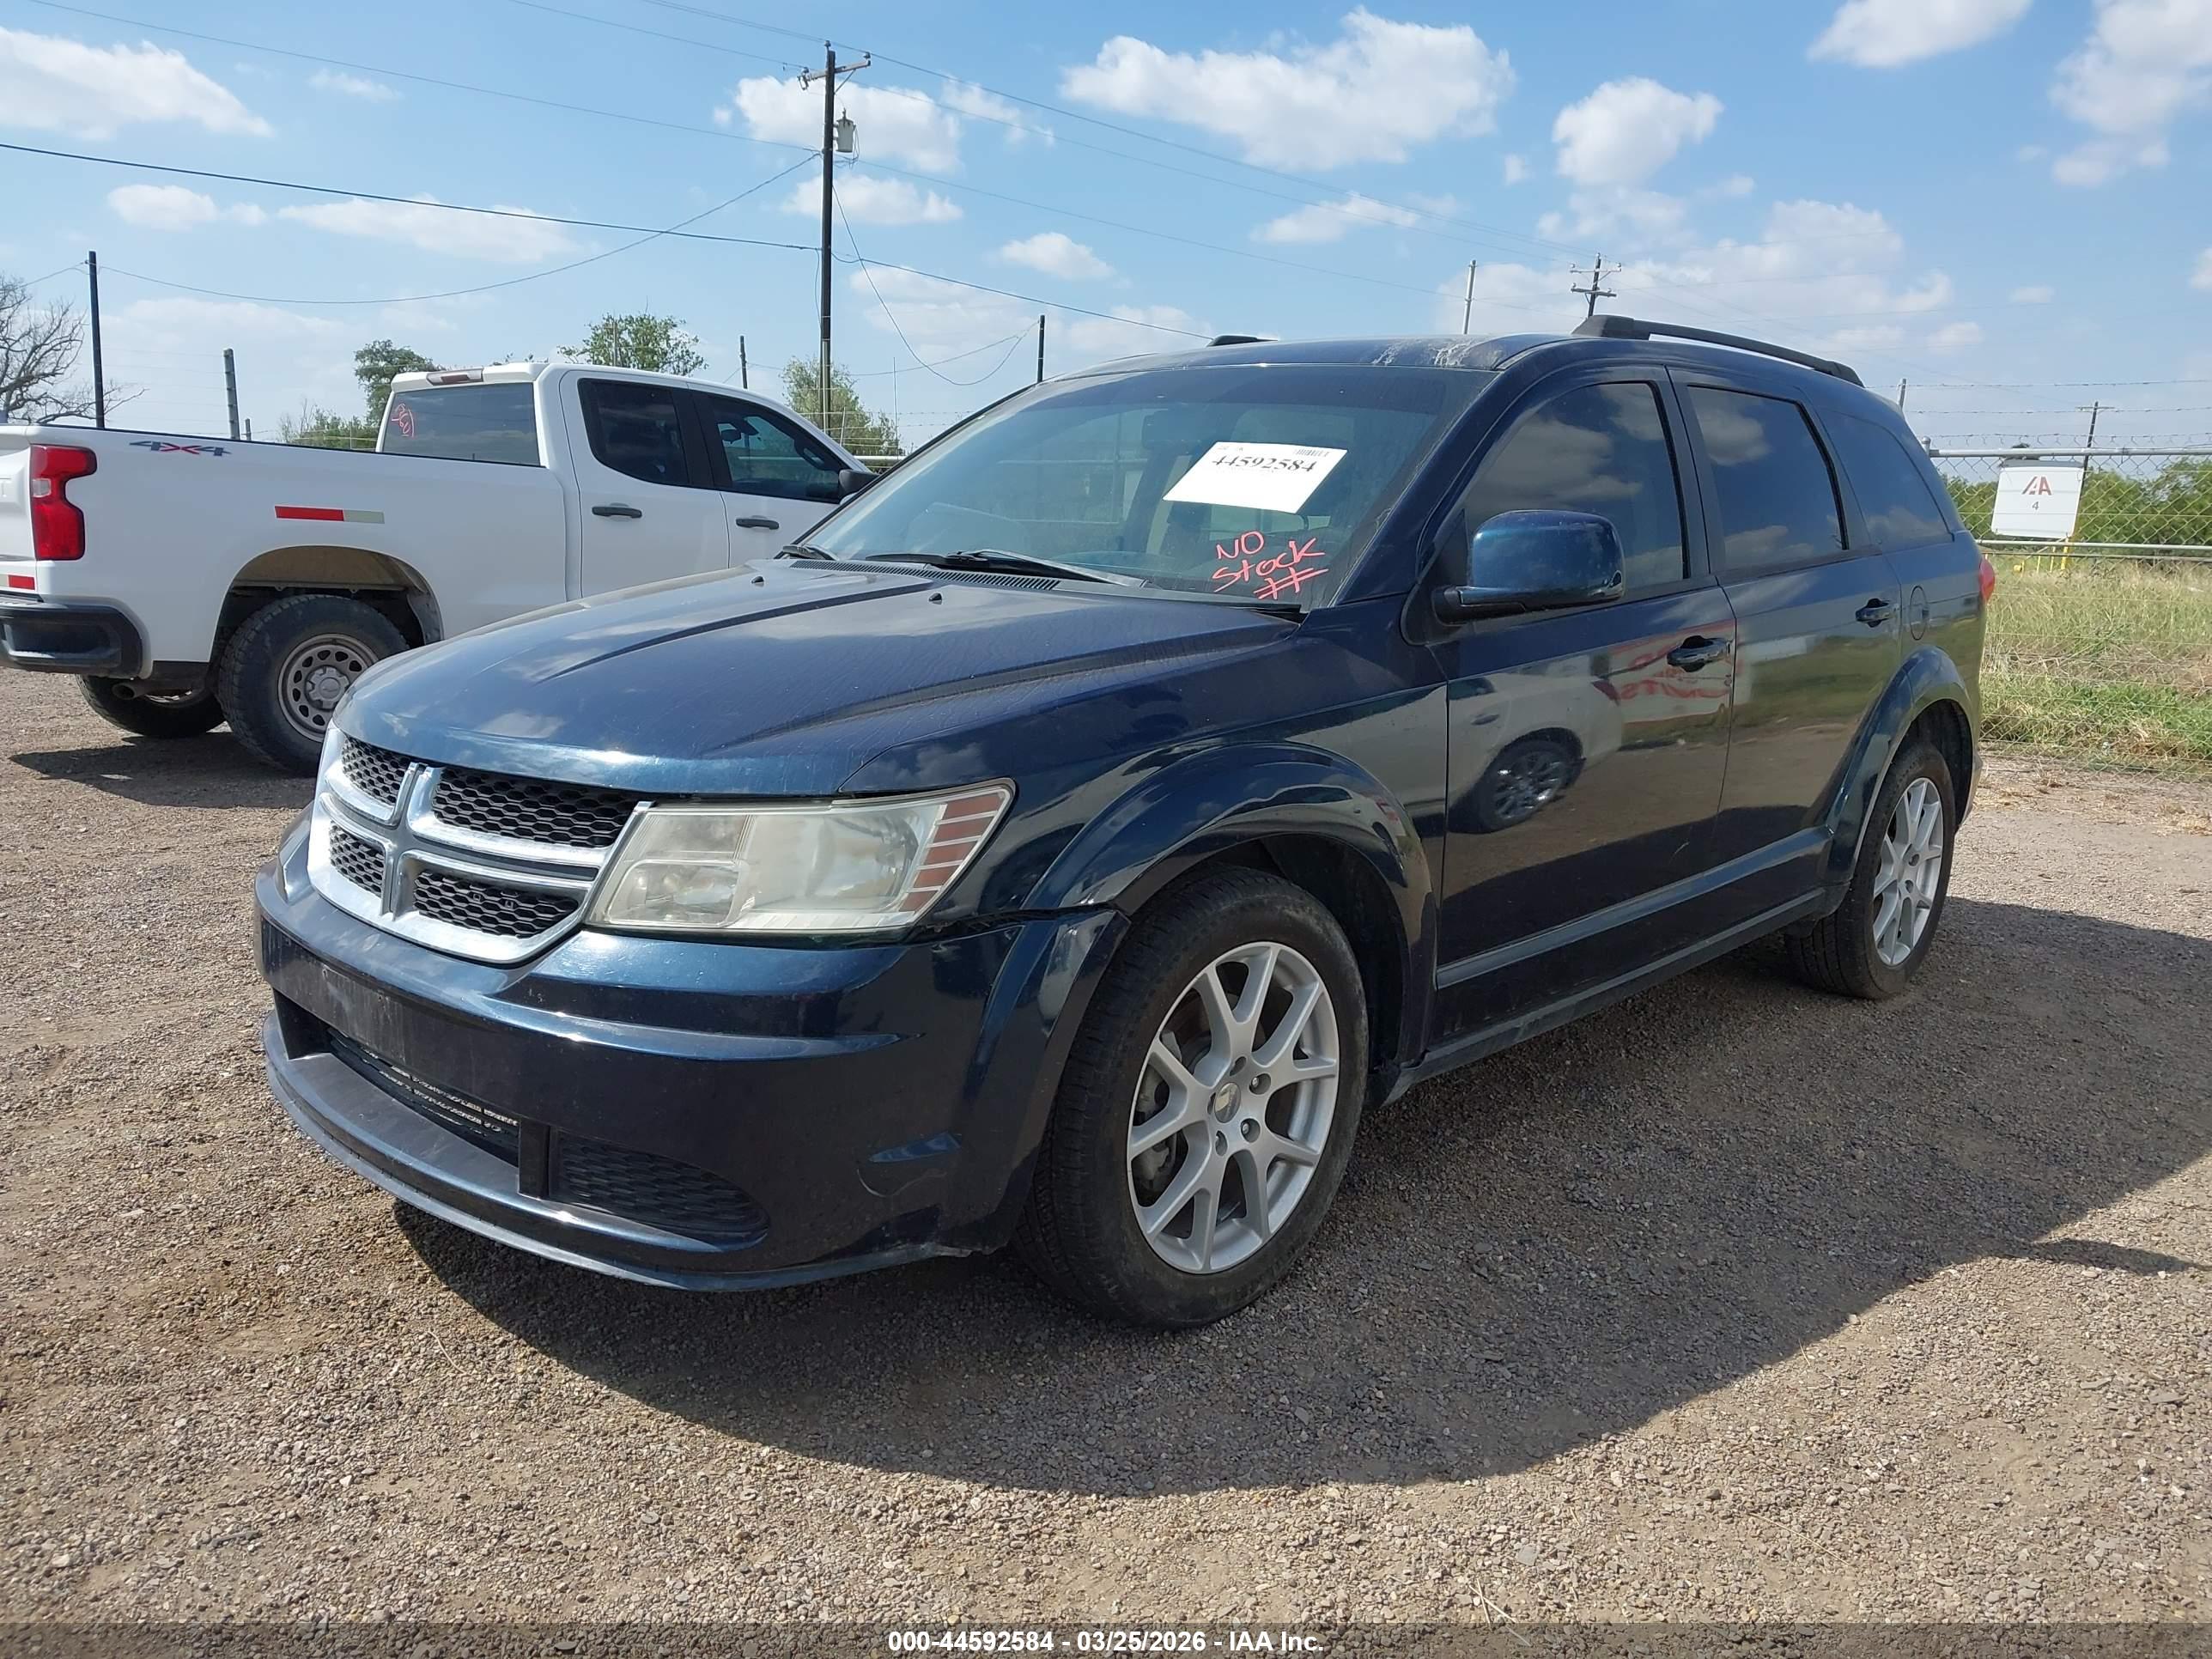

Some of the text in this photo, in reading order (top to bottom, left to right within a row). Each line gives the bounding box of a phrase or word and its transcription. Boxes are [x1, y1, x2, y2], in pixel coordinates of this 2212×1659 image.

[1212, 455, 1317, 472] 44592584
[2032, 501, 2039, 511] 4
[1216, 531, 1265, 559] NO
